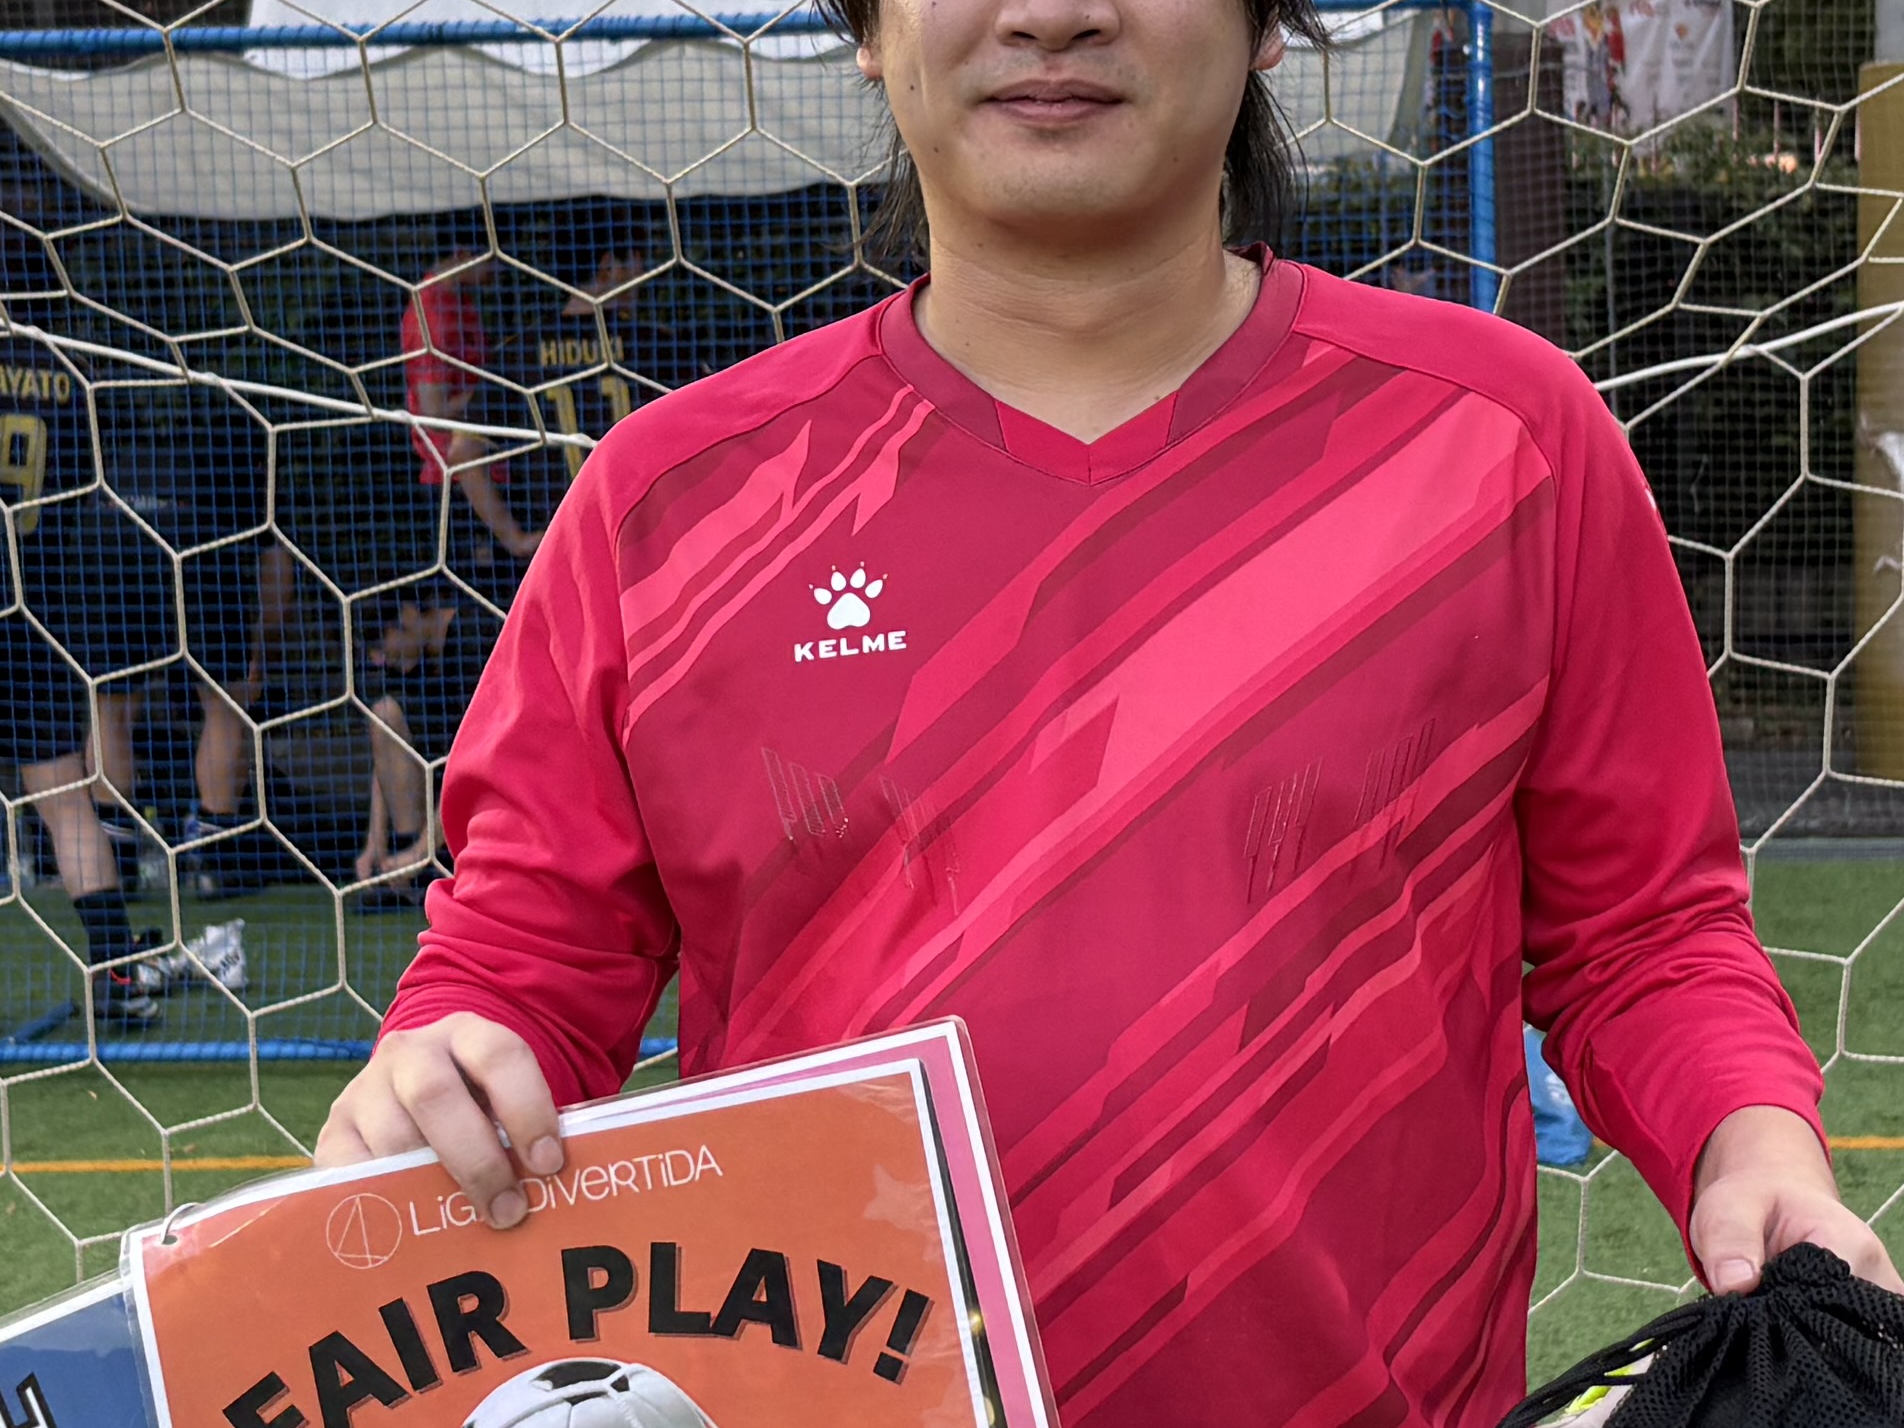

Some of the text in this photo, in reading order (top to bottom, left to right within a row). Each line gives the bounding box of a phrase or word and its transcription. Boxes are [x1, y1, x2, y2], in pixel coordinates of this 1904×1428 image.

[794, 630, 908, 663] KELME
[409, 1190, 485, 1236] LiG
[560, 1241, 934, 1385] PLAY!
